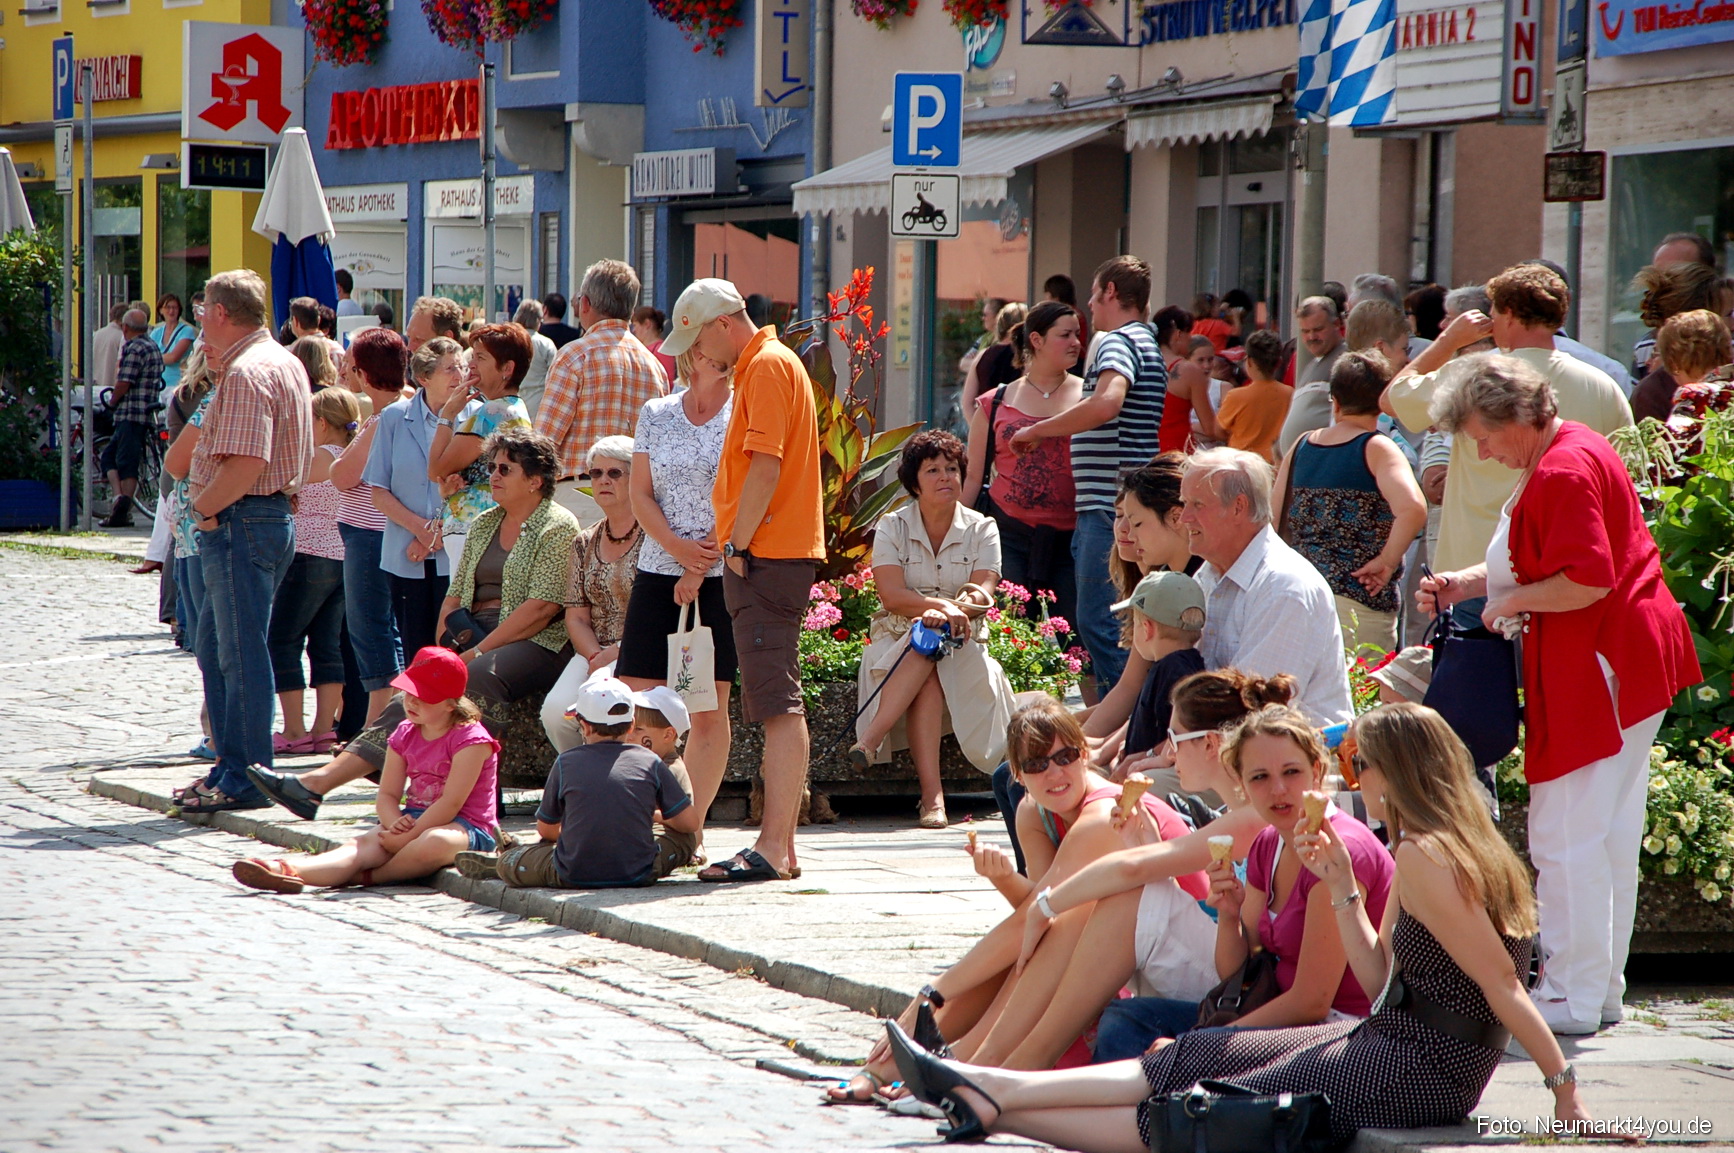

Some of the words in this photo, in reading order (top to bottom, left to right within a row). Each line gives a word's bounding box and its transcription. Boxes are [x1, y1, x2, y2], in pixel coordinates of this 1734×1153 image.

[1397, 9, 1458, 50] ARNIA
[1466, 7, 1477, 41] 2
[1634, 6, 1657, 33] TUI
[773, 0, 801, 83] TL
[57, 49, 68, 110] P
[324, 79, 480, 149] APOTHEKE
[908, 84, 946, 155] P
[198, 156, 250, 177] 14:11
[635, 156, 684, 192] KONDITOREI
[688, 154, 713, 189] WITTL
[358, 193, 395, 212] APOTHEKE
[441, 188, 476, 208] RATHAUS
[479, 186, 519, 205] THEKE
[914, 181, 935, 191] nur
